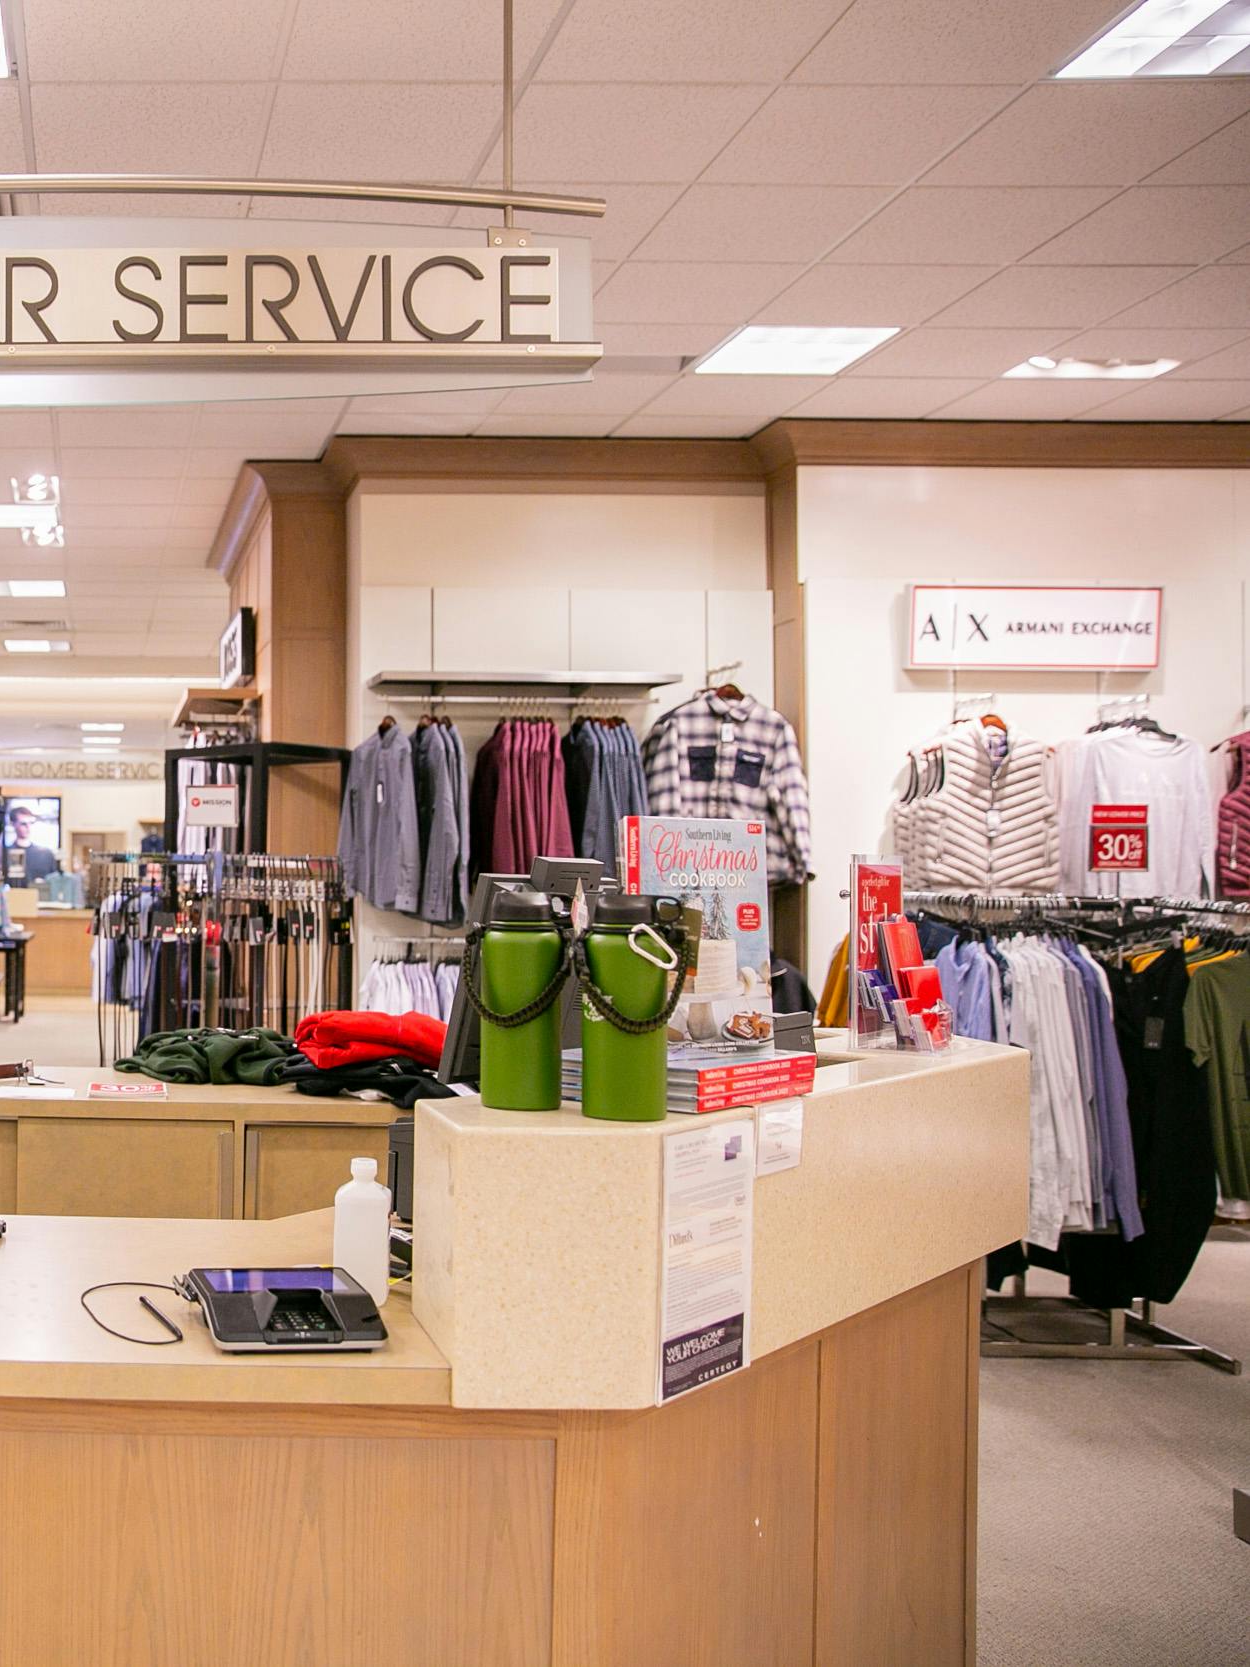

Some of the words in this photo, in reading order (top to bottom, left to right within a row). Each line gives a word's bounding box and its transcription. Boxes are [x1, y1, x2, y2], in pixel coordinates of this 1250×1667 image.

[111, 254, 553, 345] SERVICE
[1005, 622, 1064, 634] ARMANI
[1072, 622, 1152, 635] EXCHANGE
[95, 761, 161, 780] SERVIC
[202, 799, 232, 807] MISSION
[686, 828, 712, 840] Southern
[713, 829, 732, 842] Living
[650, 824, 758, 882] Christmas
[669, 873, 747, 887] COOKBOOK
[862, 887, 877, 912] the
[666, 1343, 682, 1358] WE
[682, 1327, 726, 1352] WELCOME
[666, 1350, 692, 1364] YOUR
[692, 1338, 720, 1356] CHECK
[698, 1359, 738, 1382] CERTEGY
